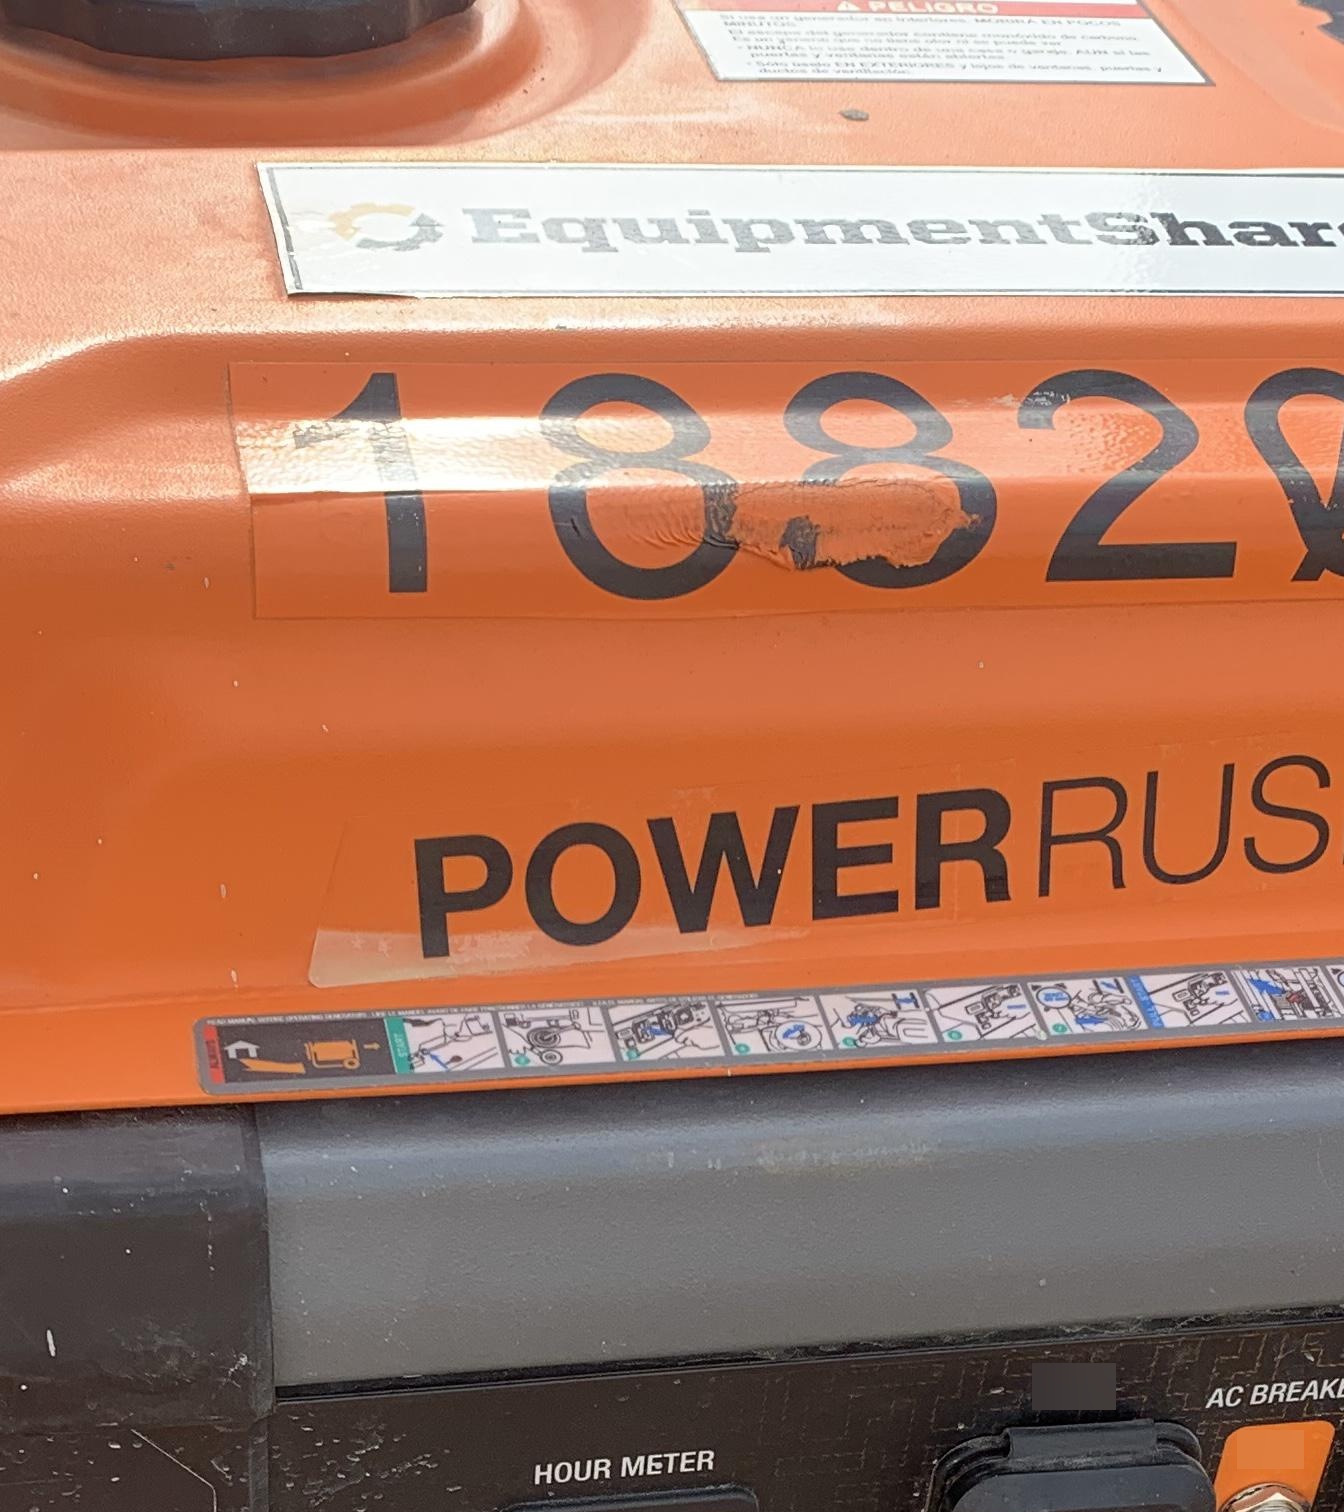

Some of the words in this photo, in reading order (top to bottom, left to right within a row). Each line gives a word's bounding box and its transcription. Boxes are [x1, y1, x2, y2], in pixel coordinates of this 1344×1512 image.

[868, 1, 998, 14] PELIGRO
[1206, 1386, 1244, 1409] AC
[533, 1458, 611, 1485] HOUR
[620, 1449, 716, 1478] METER
